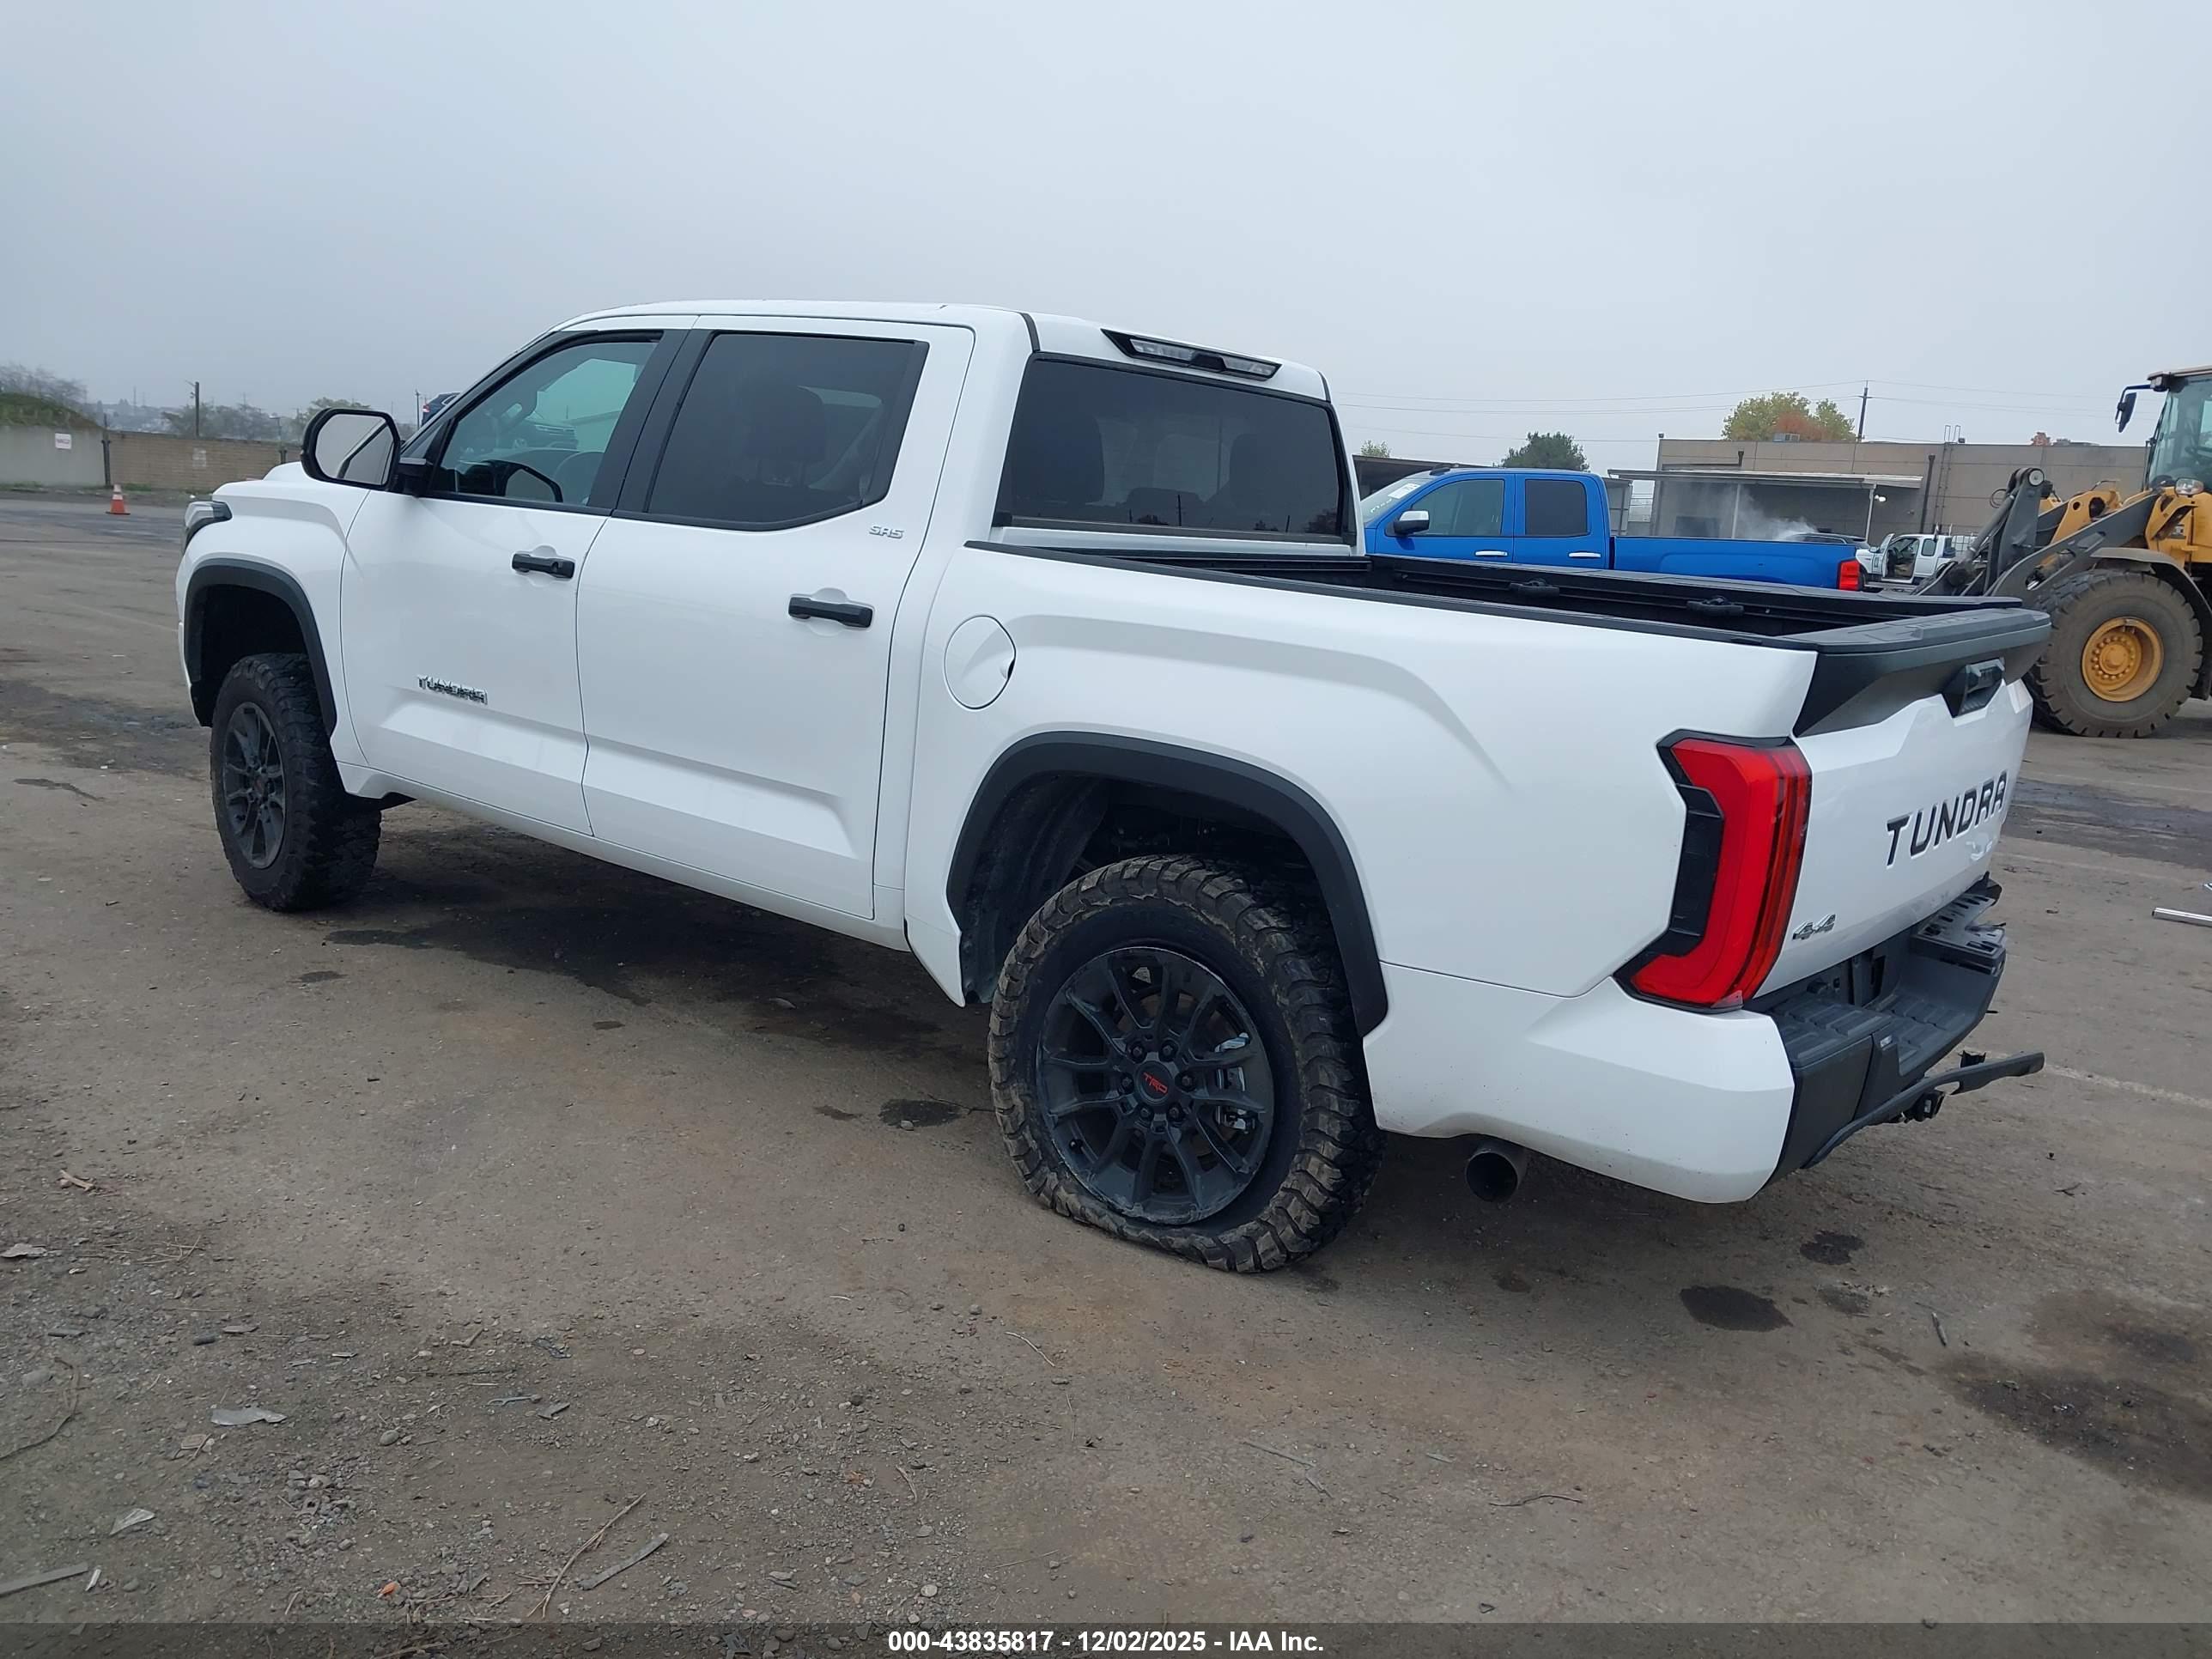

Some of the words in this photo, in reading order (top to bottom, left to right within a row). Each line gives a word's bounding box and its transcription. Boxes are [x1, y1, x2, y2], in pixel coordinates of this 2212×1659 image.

[417, 675, 488, 705] TUNDRA
[1886, 769, 2008, 868] TUNDRA
[1143, 1072, 1169, 1094] TRD
